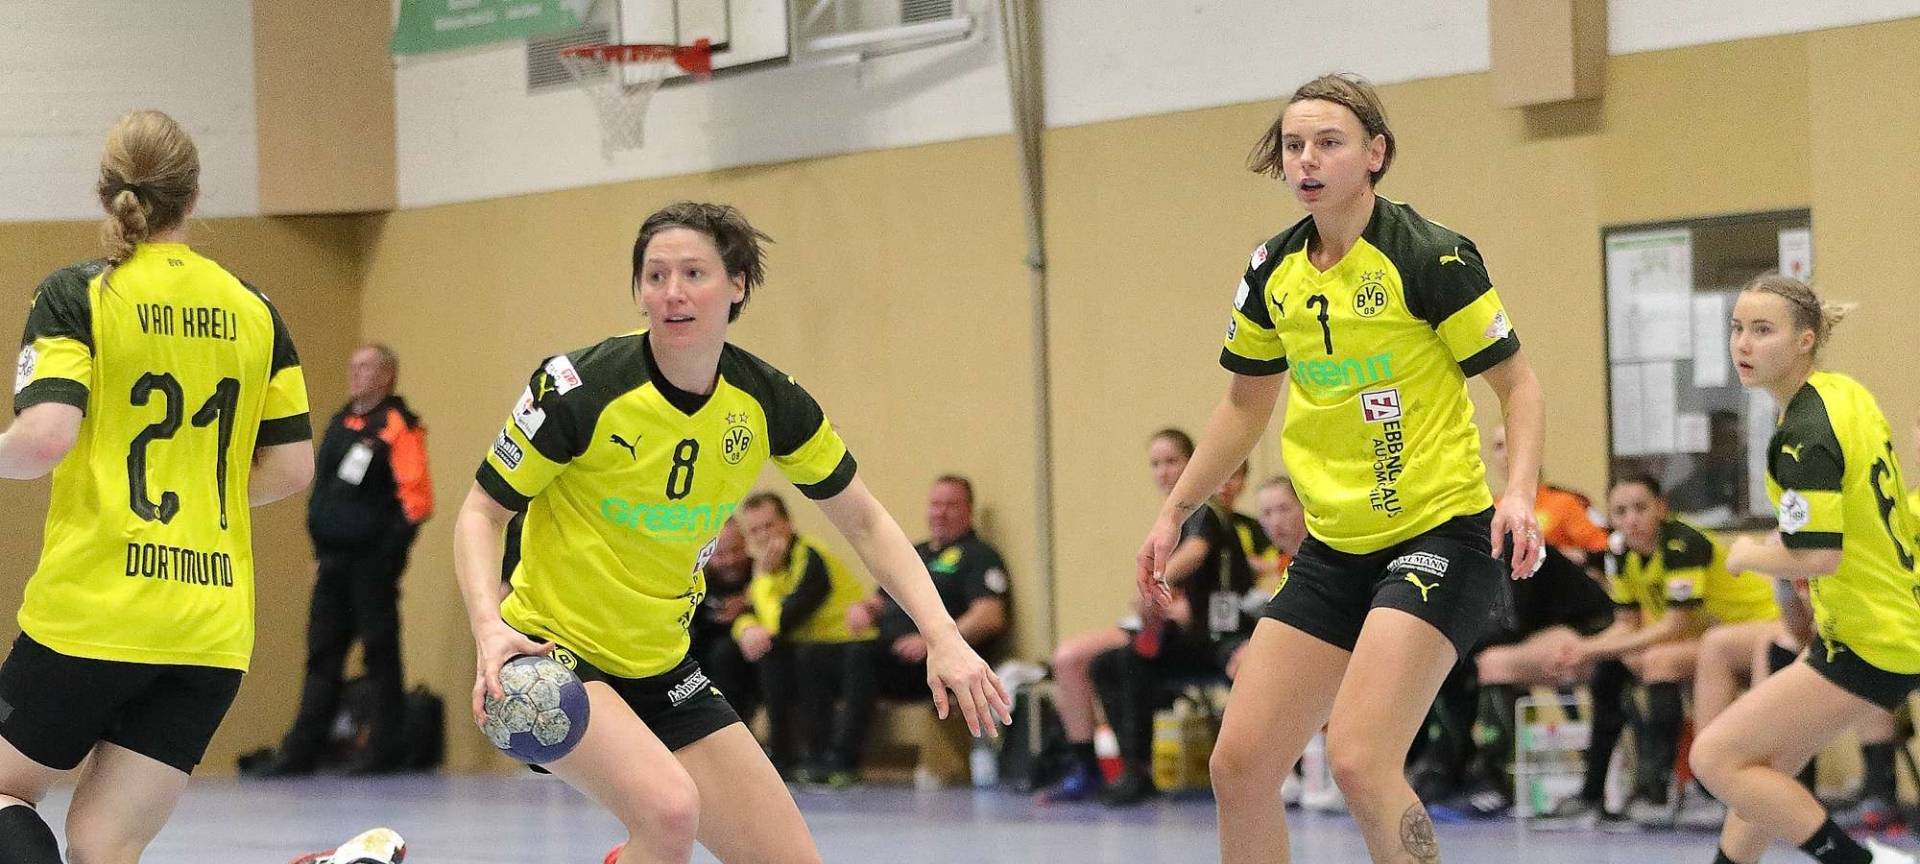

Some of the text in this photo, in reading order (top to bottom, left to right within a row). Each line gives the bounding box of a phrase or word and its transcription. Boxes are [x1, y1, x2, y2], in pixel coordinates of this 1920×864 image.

[1357, 286, 1384, 309] BVB
[1364, 306, 1375, 315] 09
[137, 303, 237, 342] VAN KREIJ
[1306, 294, 1333, 355] 7
[1296, 356, 1364, 386] reen
[127, 371, 241, 531] 21
[725, 429, 750, 454] BVB
[665, 438, 701, 501] 8
[125, 542, 234, 587] DORTMUND
